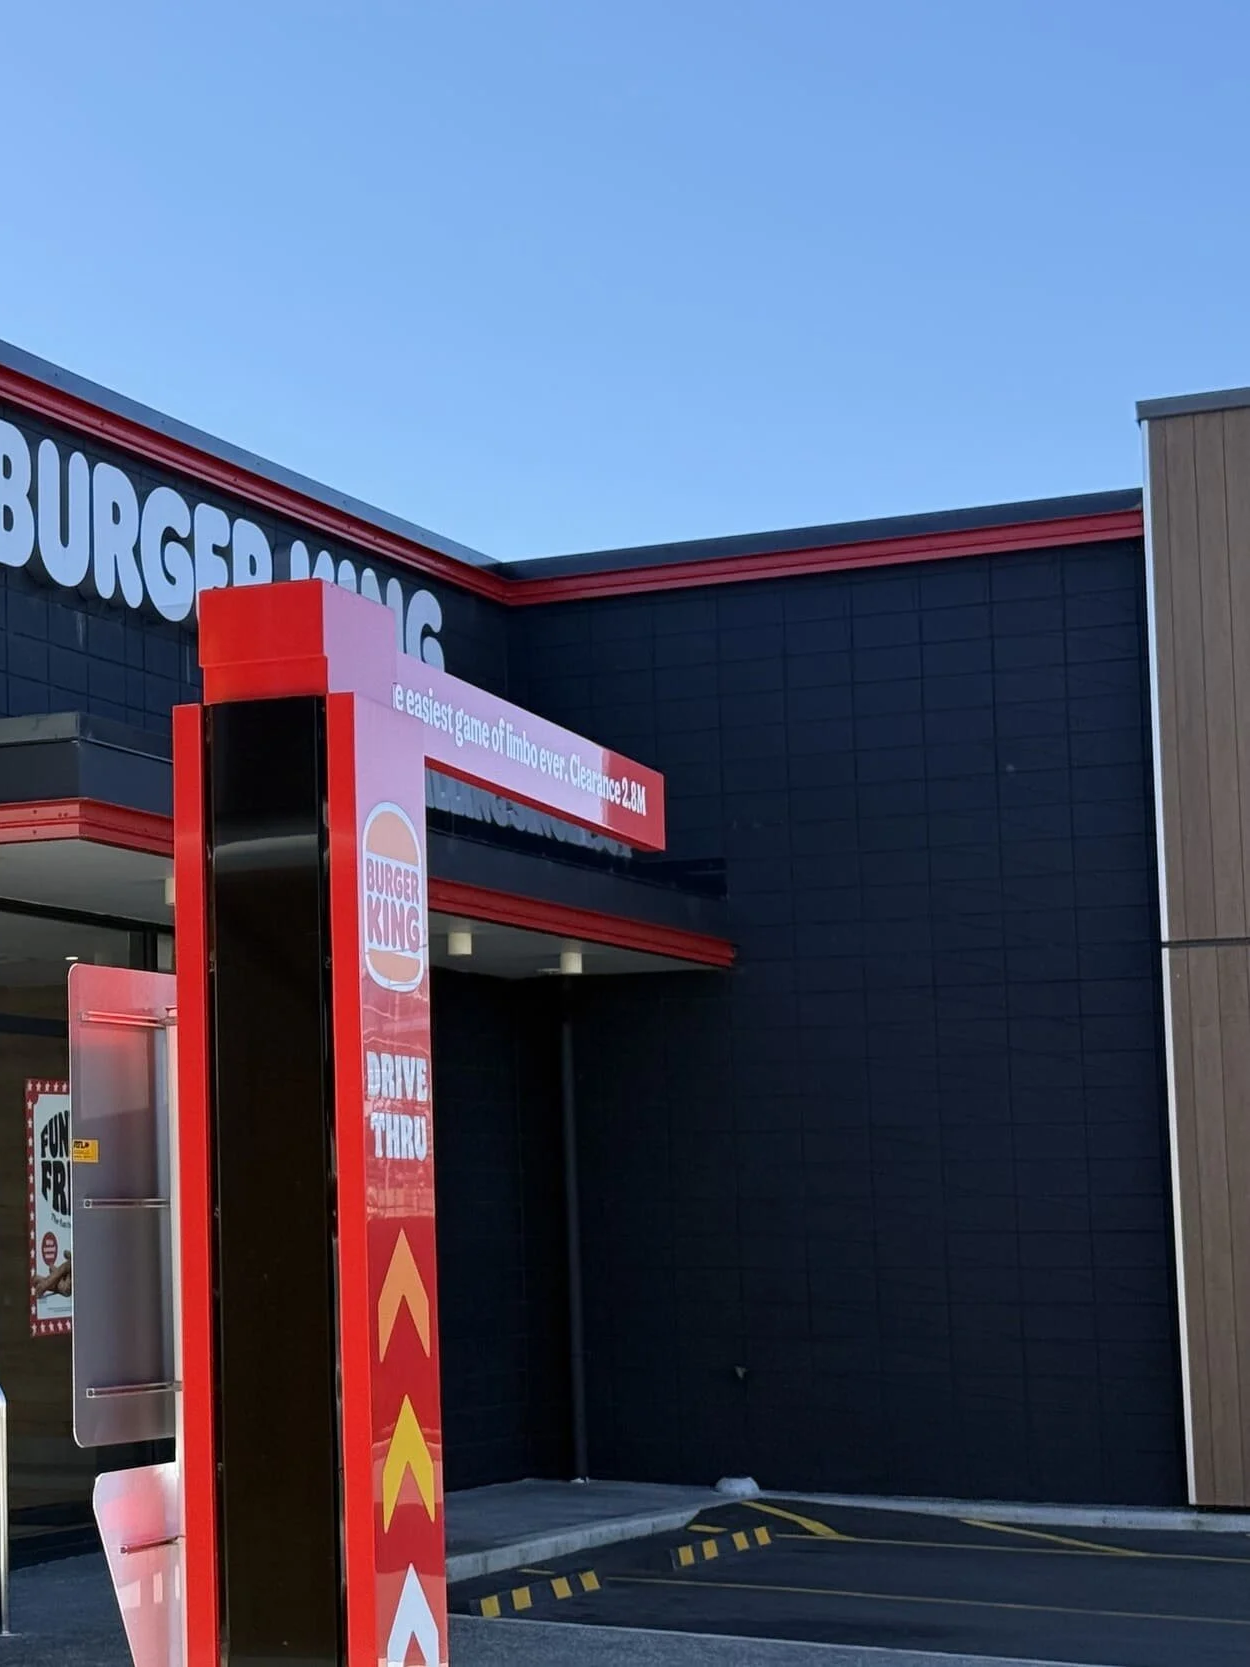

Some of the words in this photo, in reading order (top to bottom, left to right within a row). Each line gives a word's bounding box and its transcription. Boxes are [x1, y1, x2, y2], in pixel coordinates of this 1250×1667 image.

[406, 687, 454, 735] easiest
[455, 707, 490, 748] game
[491, 717, 505, 755] of
[506, 722, 537, 769] limbo
[569, 753, 621, 805] Clearance
[621, 776, 647, 817] 2.8M
[366, 858, 420, 905] BURGER
[367, 894, 421, 954] KING
[366, 1051, 428, 1102] DRIVE
[370, 1111, 427, 1162] THRU
